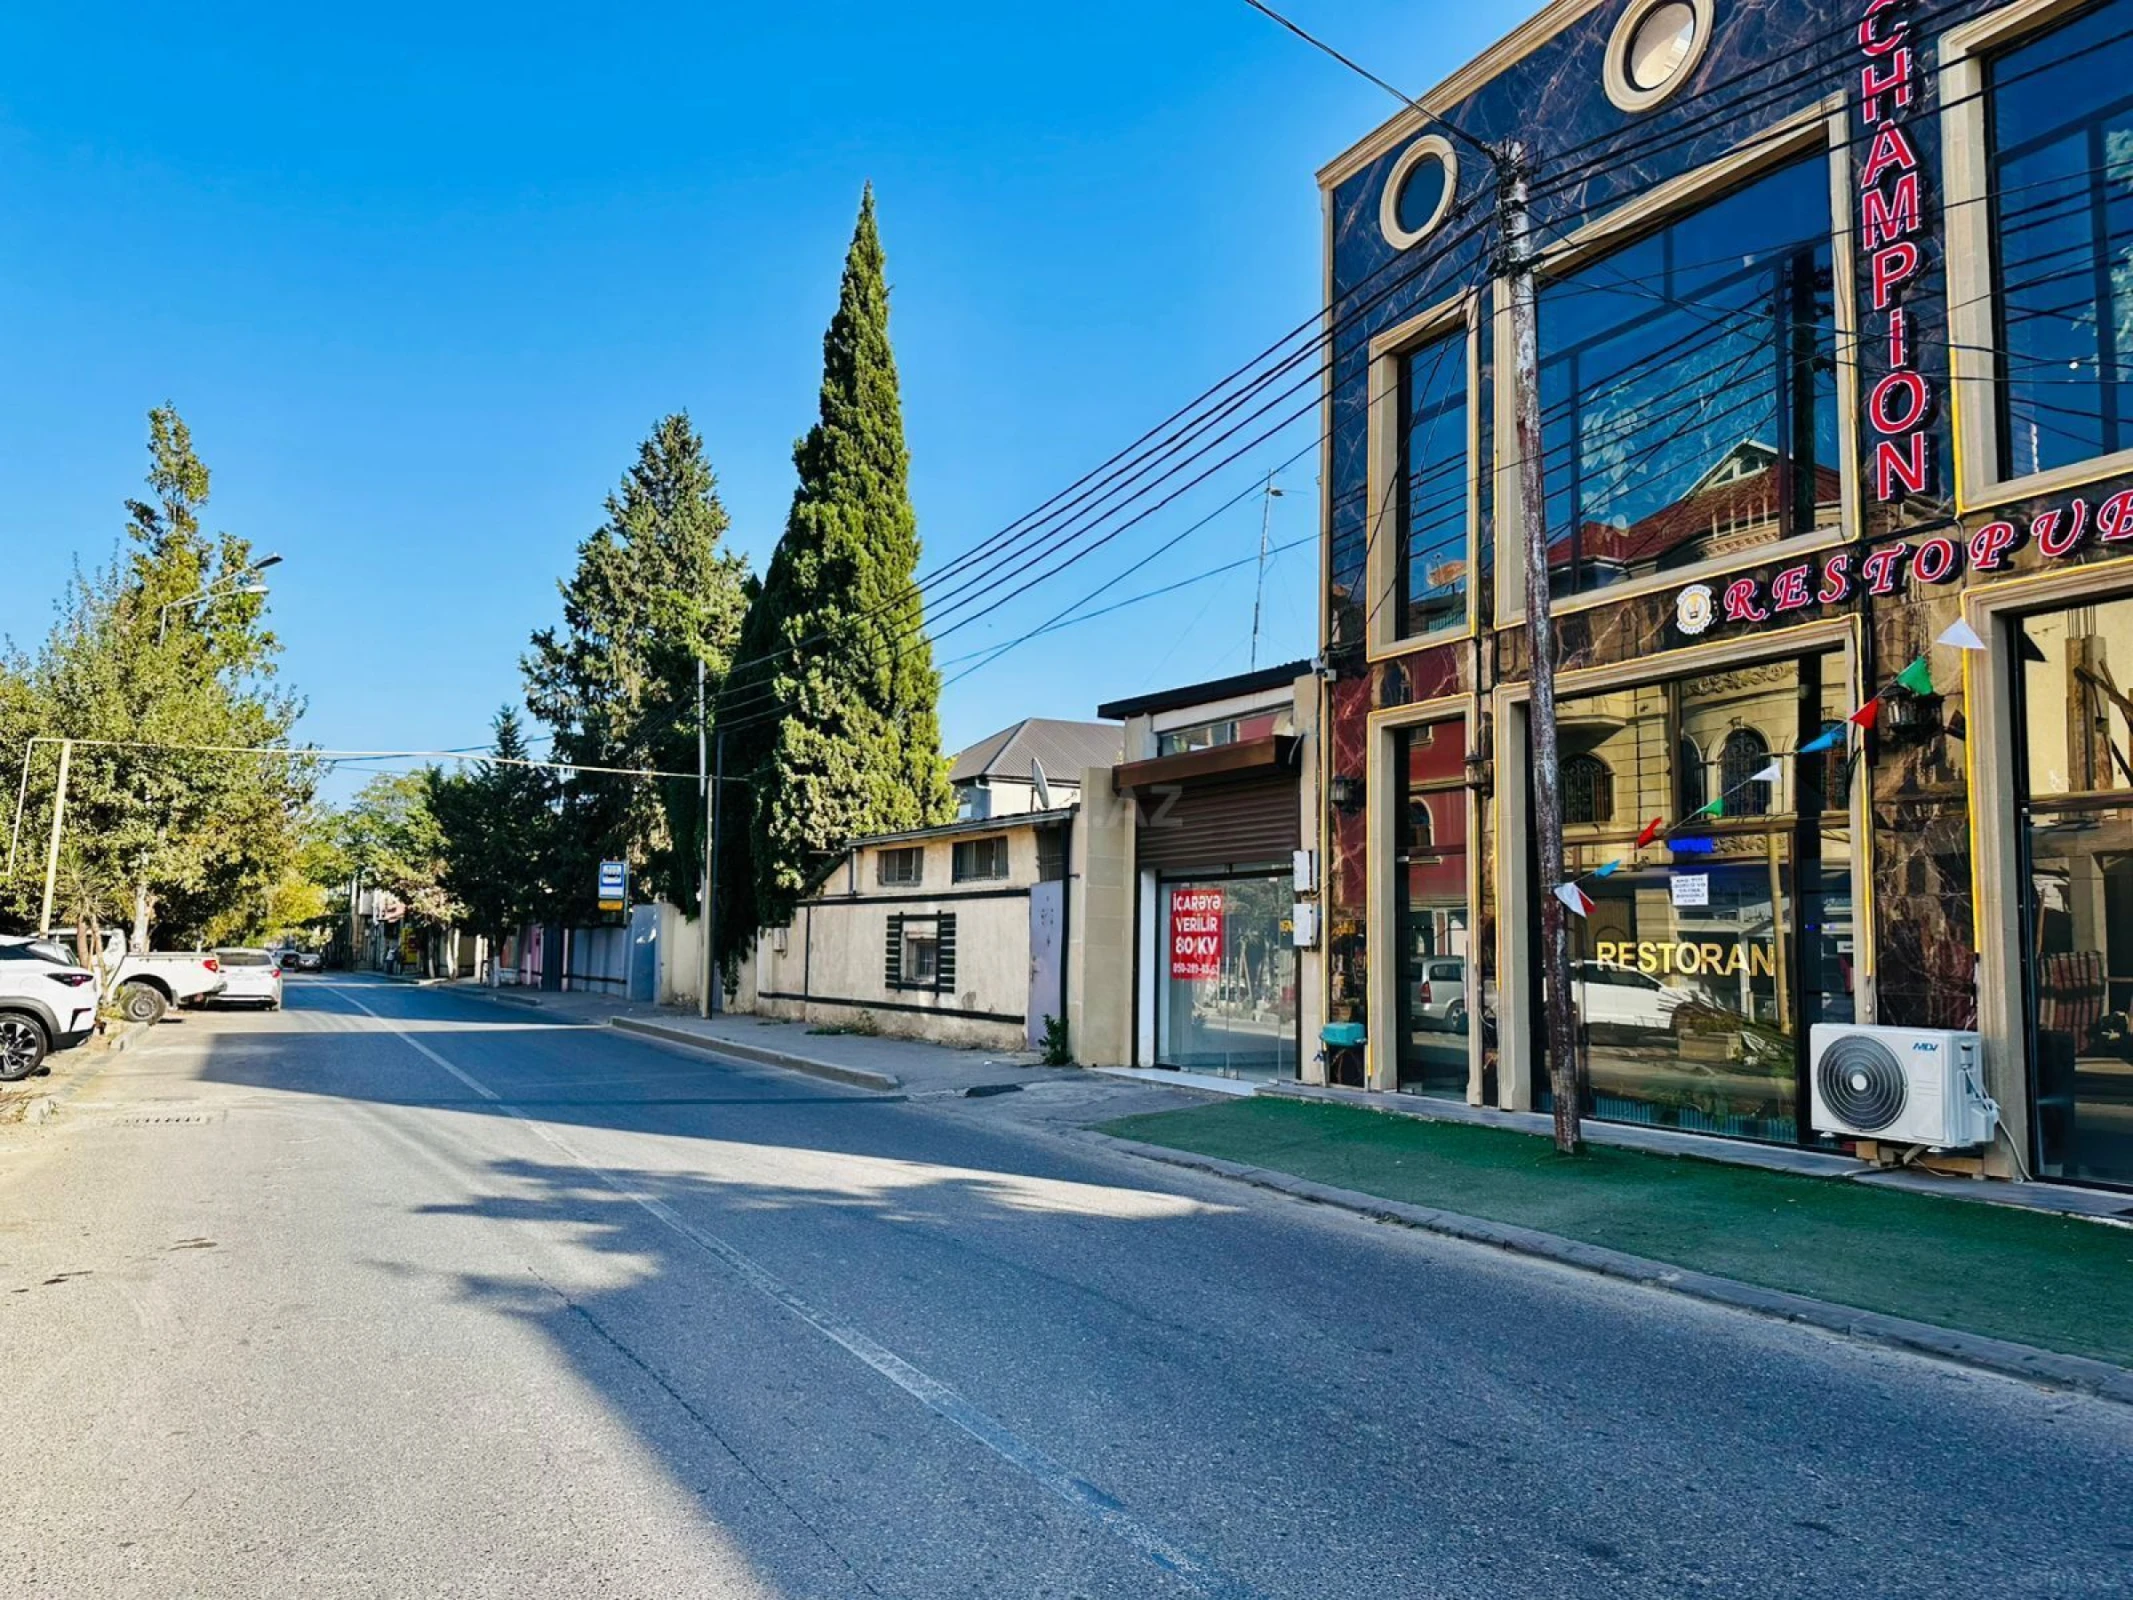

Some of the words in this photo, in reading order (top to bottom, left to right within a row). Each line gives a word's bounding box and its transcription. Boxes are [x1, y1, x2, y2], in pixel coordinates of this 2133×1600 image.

[1175, 912, 1218, 933] VERİLİR
[1175, 935, 1195, 956] 80
[1197, 935, 1218, 956] KV
[1596, 941, 1775, 977] RESTORAN
